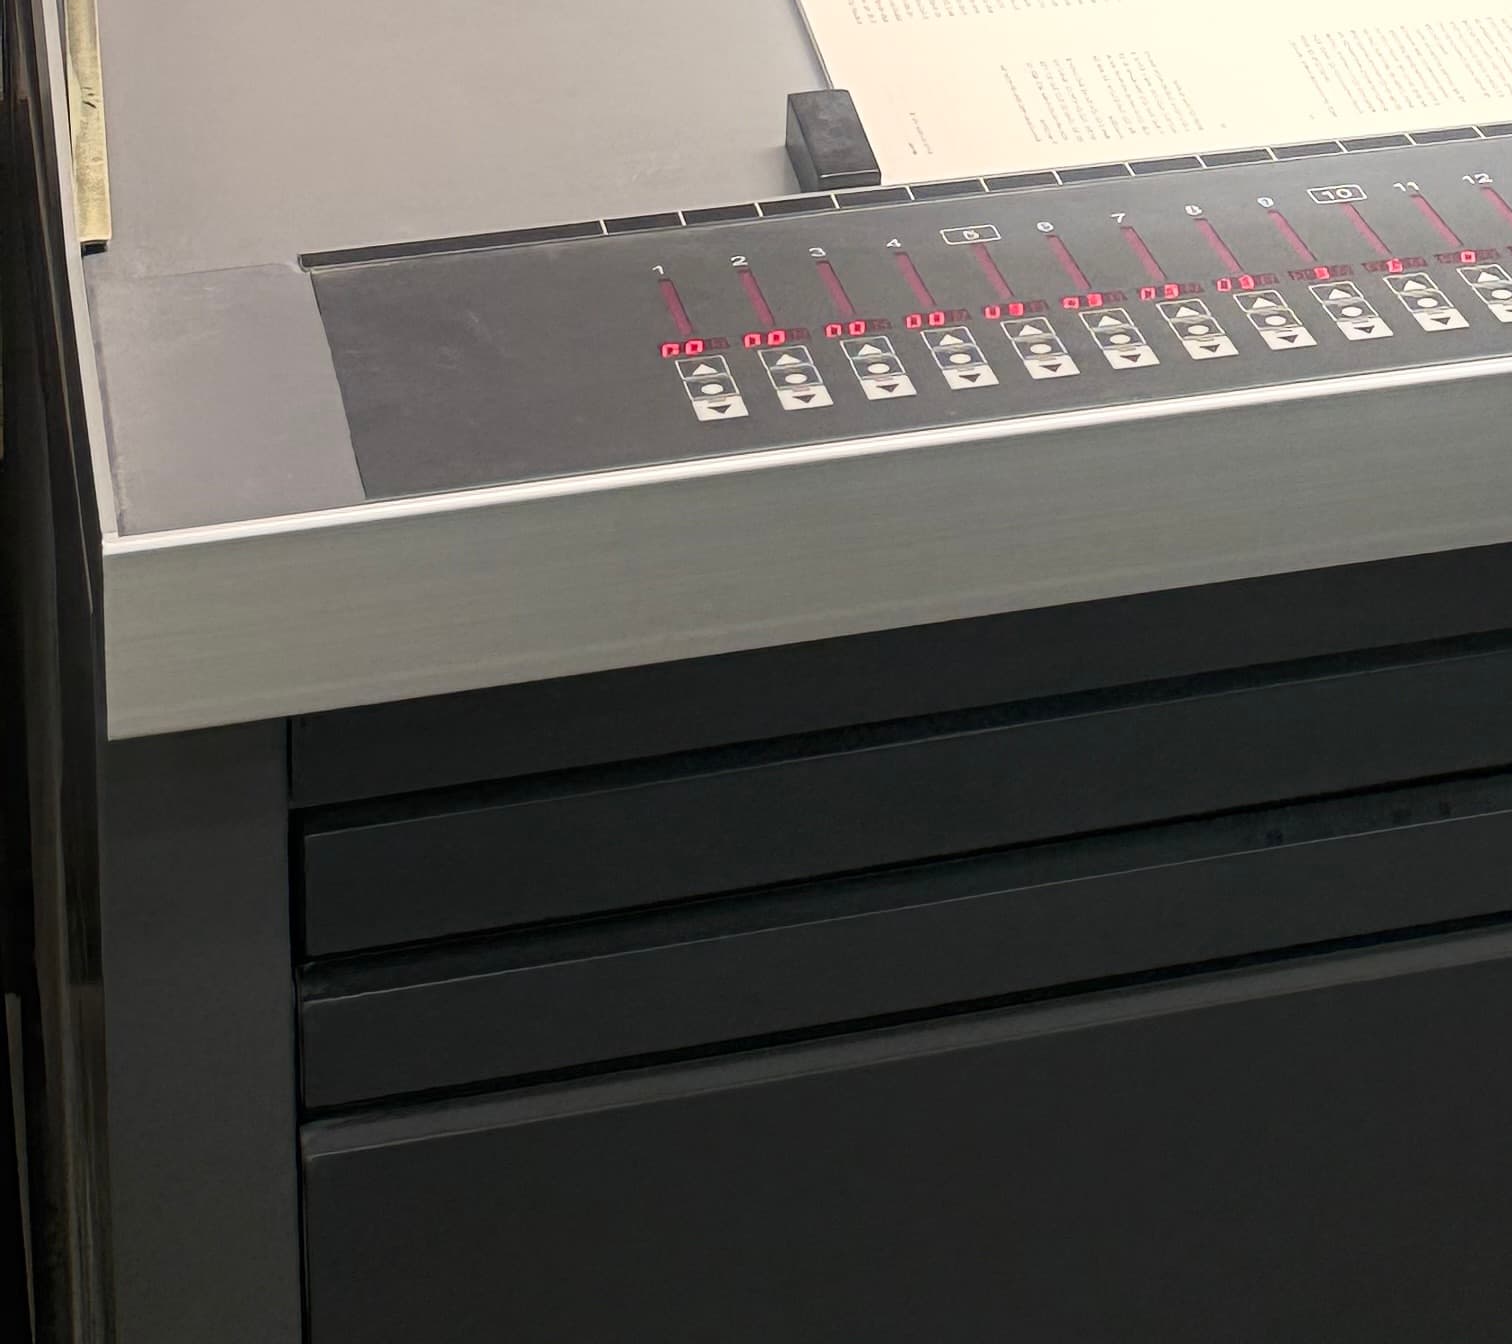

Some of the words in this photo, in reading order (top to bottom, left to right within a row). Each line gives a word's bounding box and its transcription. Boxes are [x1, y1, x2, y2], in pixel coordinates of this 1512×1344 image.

[652, 265, 664, 275] 1
[730, 255, 749, 267] 2
[809, 247, 827, 257] 3
[886, 238, 902, 249] 4
[1111, 212, 1126, 224] 7
[1320, 188, 1353, 200] 10
[1393, 181, 1420, 192] 11
[1462, 172, 1494, 185] 12
